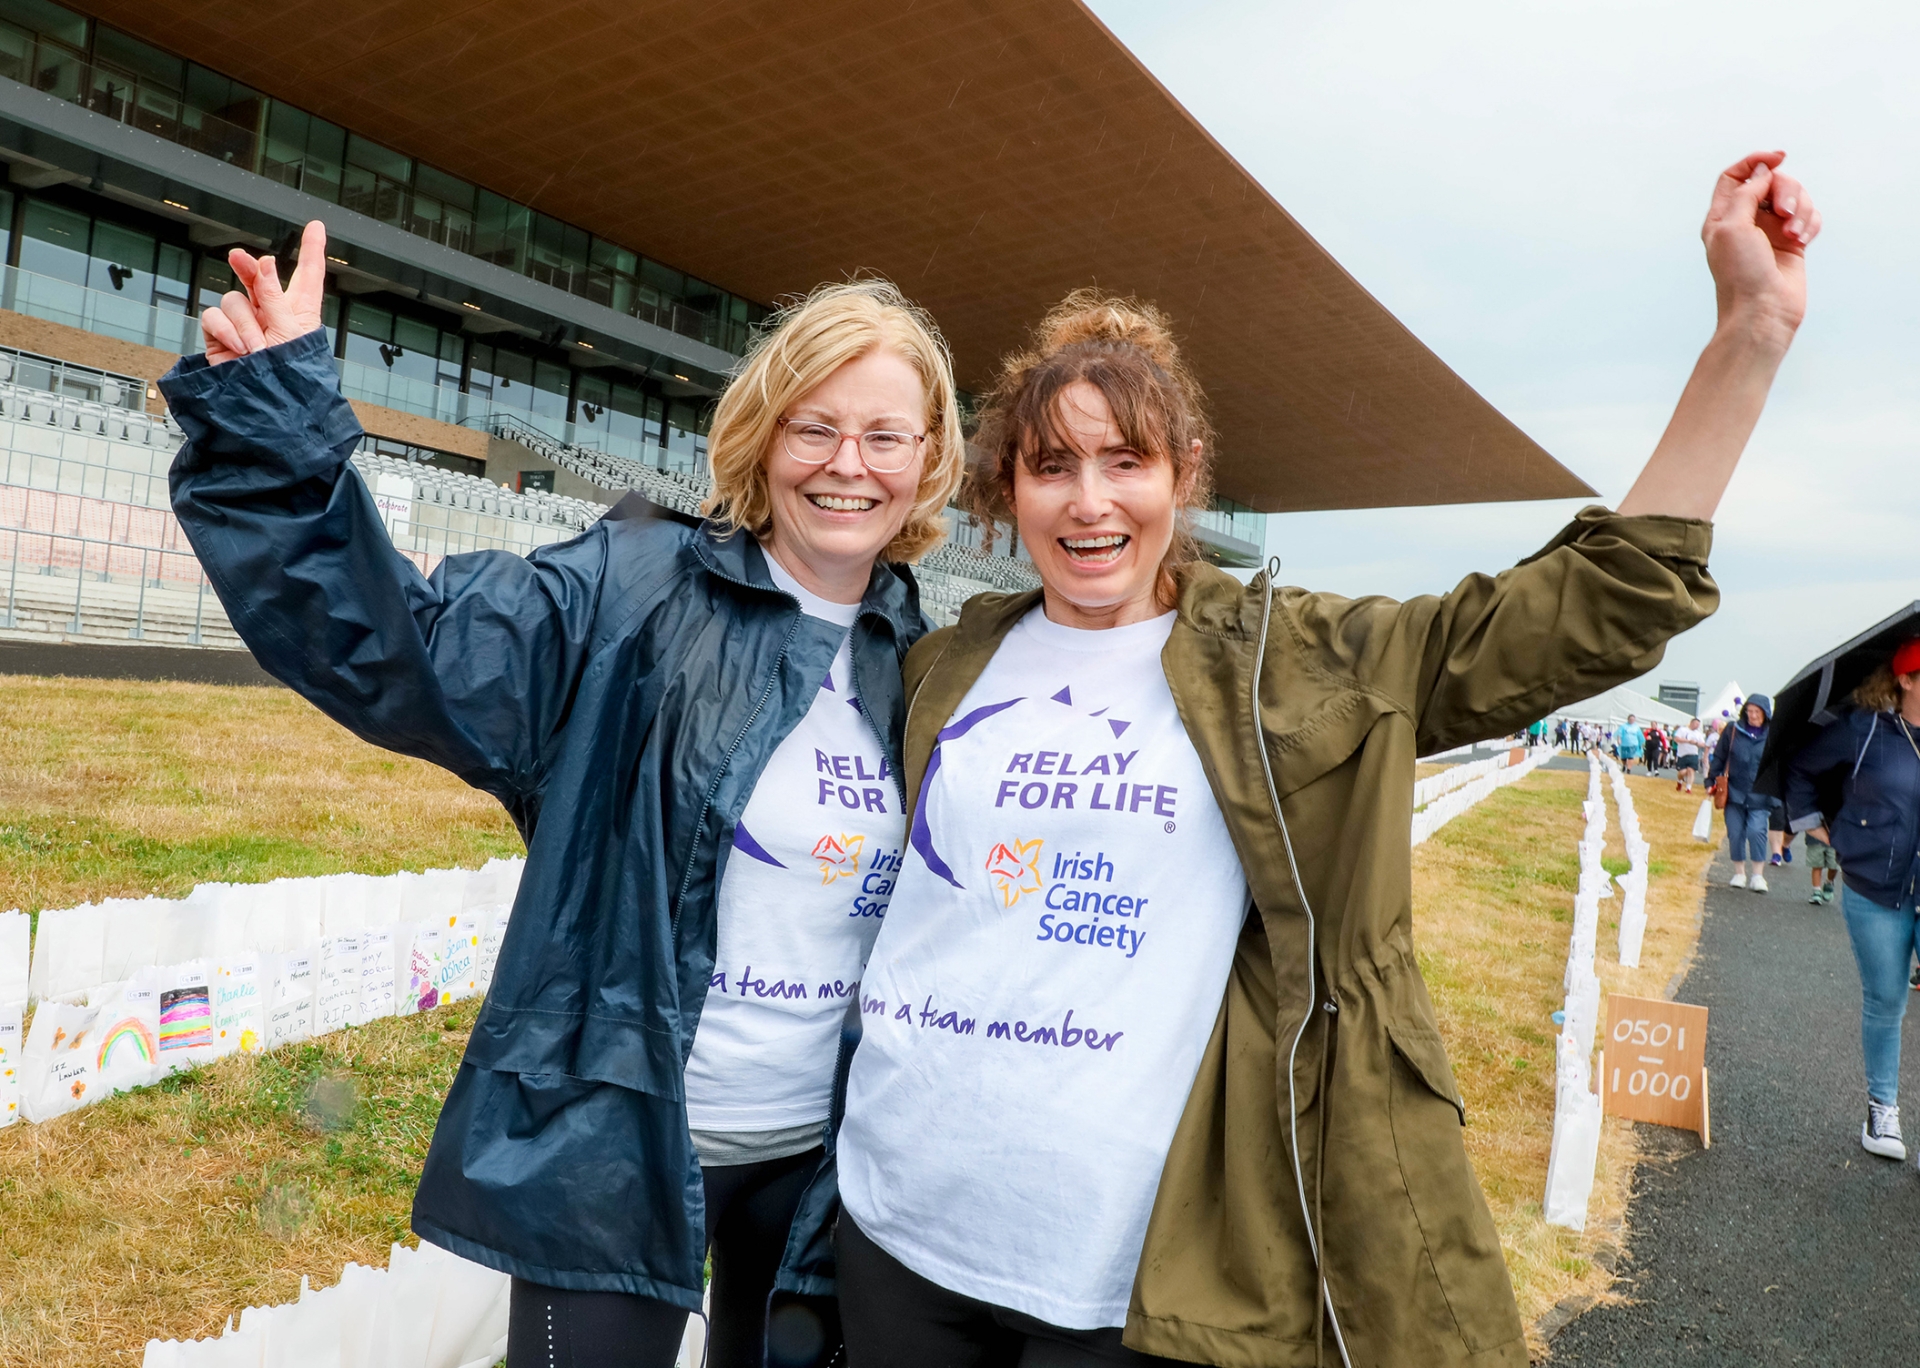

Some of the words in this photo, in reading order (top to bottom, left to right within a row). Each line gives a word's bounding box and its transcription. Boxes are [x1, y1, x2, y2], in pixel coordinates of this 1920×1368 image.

[377, 498, 408, 512] Celebrate
[1006, 749, 1139, 776] RELAY
[818, 778, 888, 814] FOR
[994, 780, 1079, 810] FOR
[1089, 782, 1178, 818] LIFE
[1052, 851, 1114, 882] Irish
[1044, 883, 1149, 919] Cancer
[1036, 914, 1147, 959] Society
[217, 982, 257, 1007] Charlie
[709, 972, 727, 993] a
[736, 966, 807, 999] team
[895, 1003, 911, 1025] a
[919, 995, 975, 1036] team
[986, 1009, 1124, 1052] member
[1613, 1018, 1686, 1051] 0501
[1612, 1067, 1691, 1102] 1000
